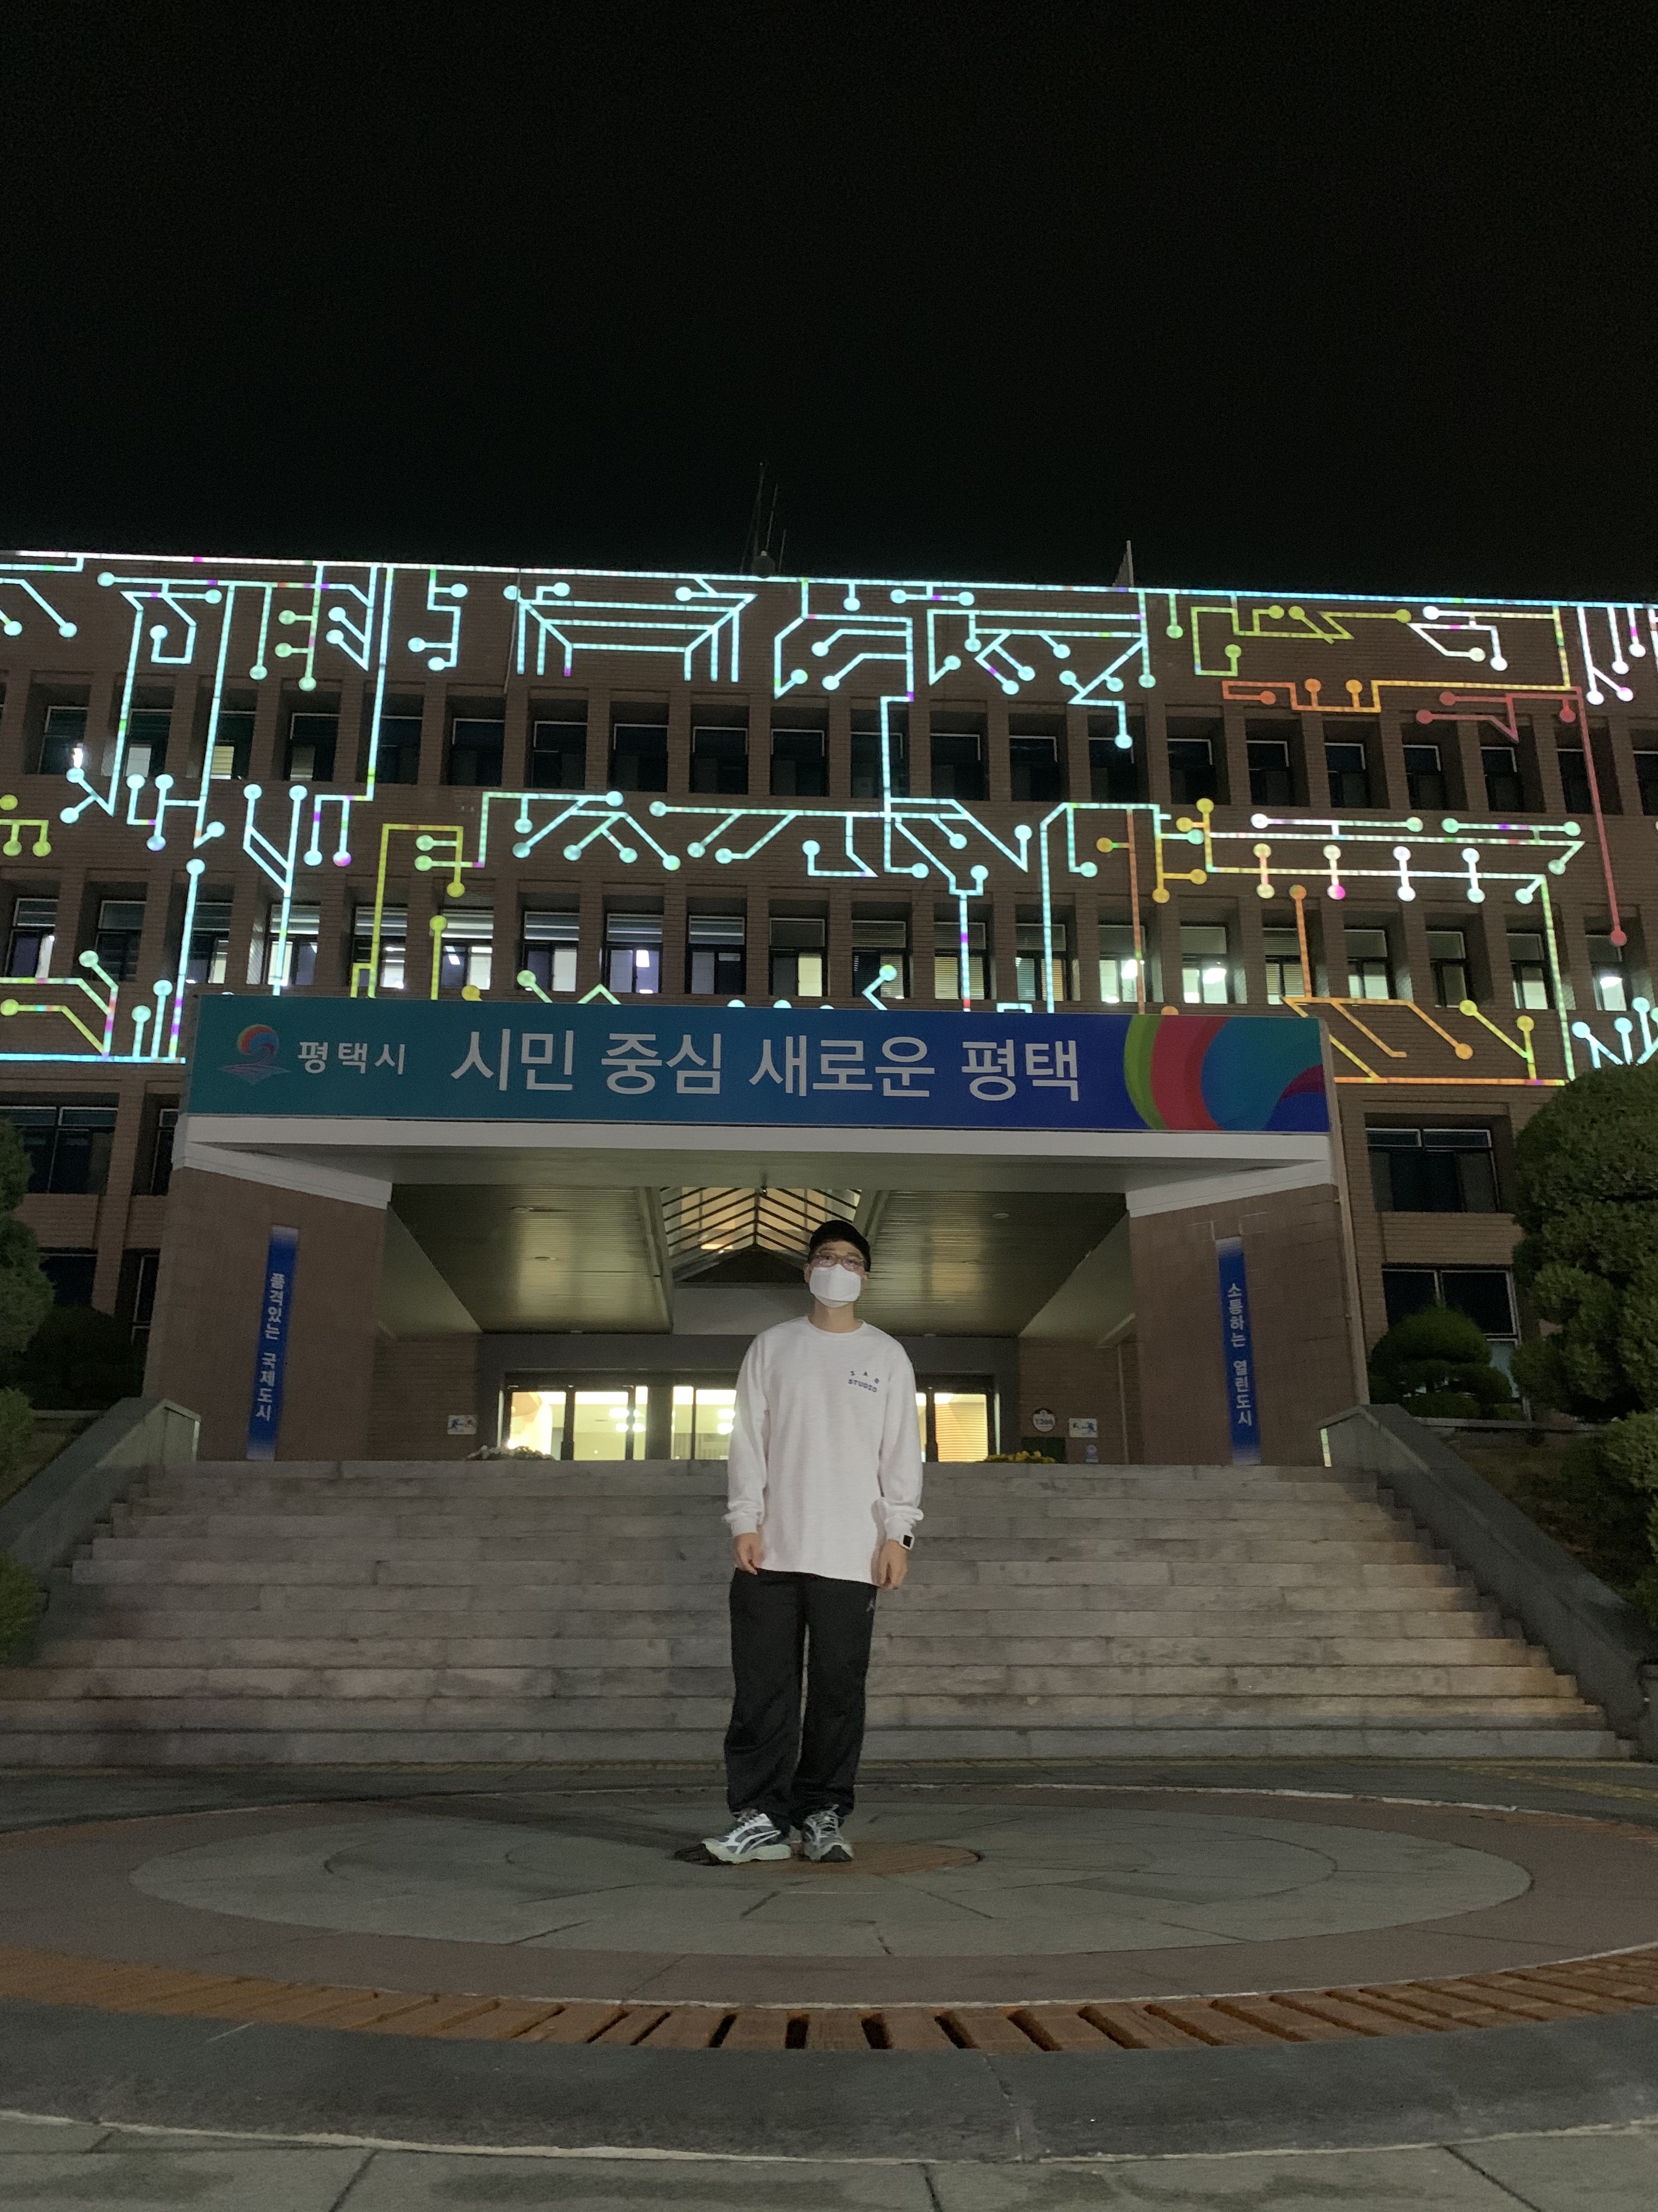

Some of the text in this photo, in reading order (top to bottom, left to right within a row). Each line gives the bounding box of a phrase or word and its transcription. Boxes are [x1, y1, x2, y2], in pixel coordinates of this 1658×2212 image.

[298, 1042, 405, 1075] 평택시
[450, 1028, 1079, 1102] 시민 중심 새로운 평택
[256, 1273, 285, 1421] 품격있는 국제도시
[1228, 1283, 1252, 1426] 소통하는 열린도시
[848, 1379, 877, 1393] STUDIO
